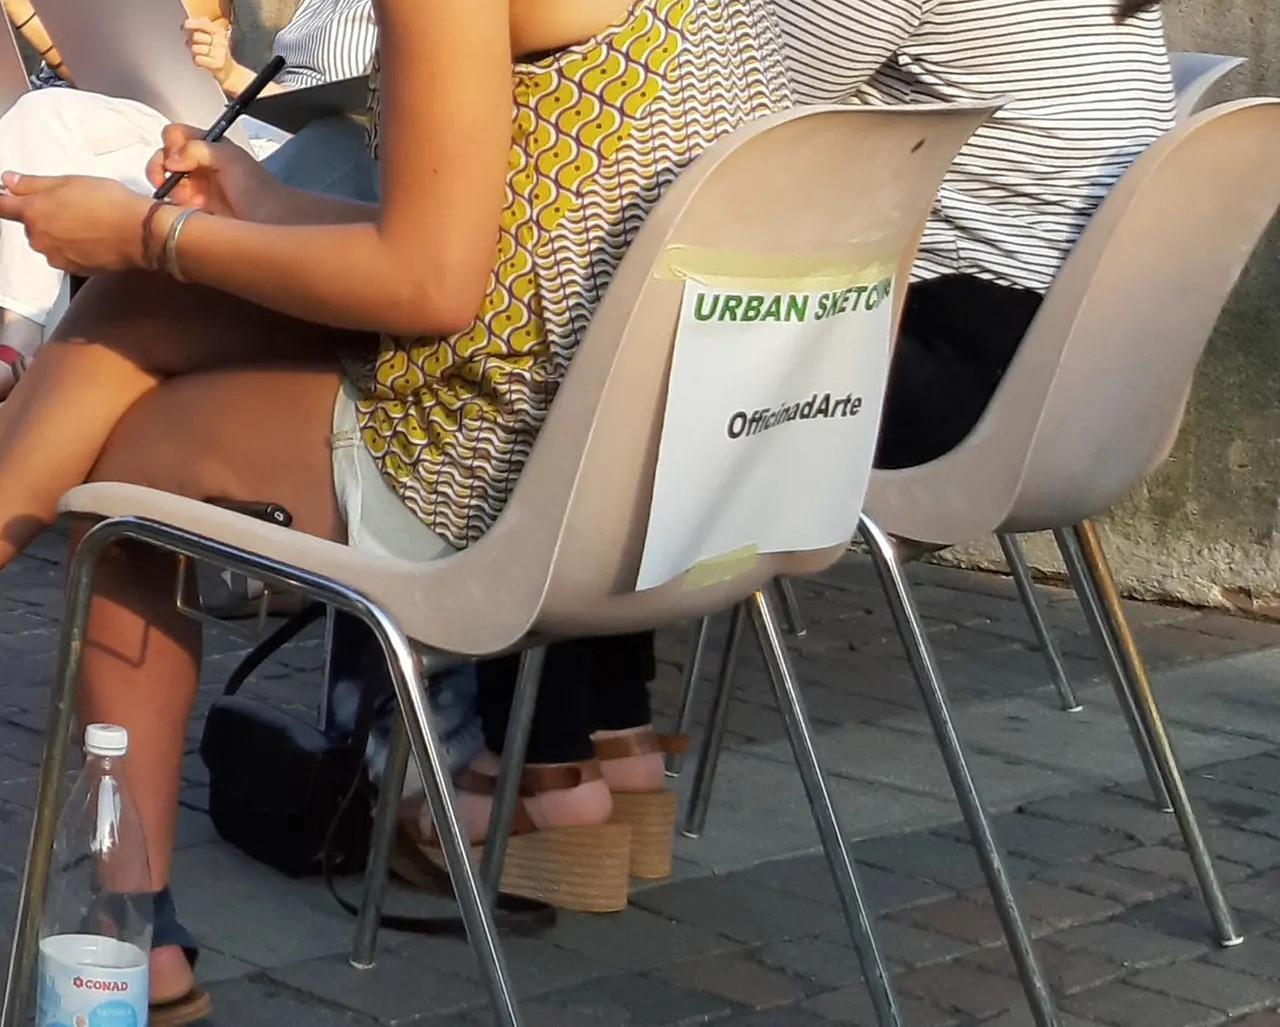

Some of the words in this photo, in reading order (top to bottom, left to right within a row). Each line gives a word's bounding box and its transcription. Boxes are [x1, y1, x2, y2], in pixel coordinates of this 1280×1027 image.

[693, 292, 809, 323] URBAN
[727, 392, 863, 440] OfficinadArte
[84, 979, 129, 992] CONAD
